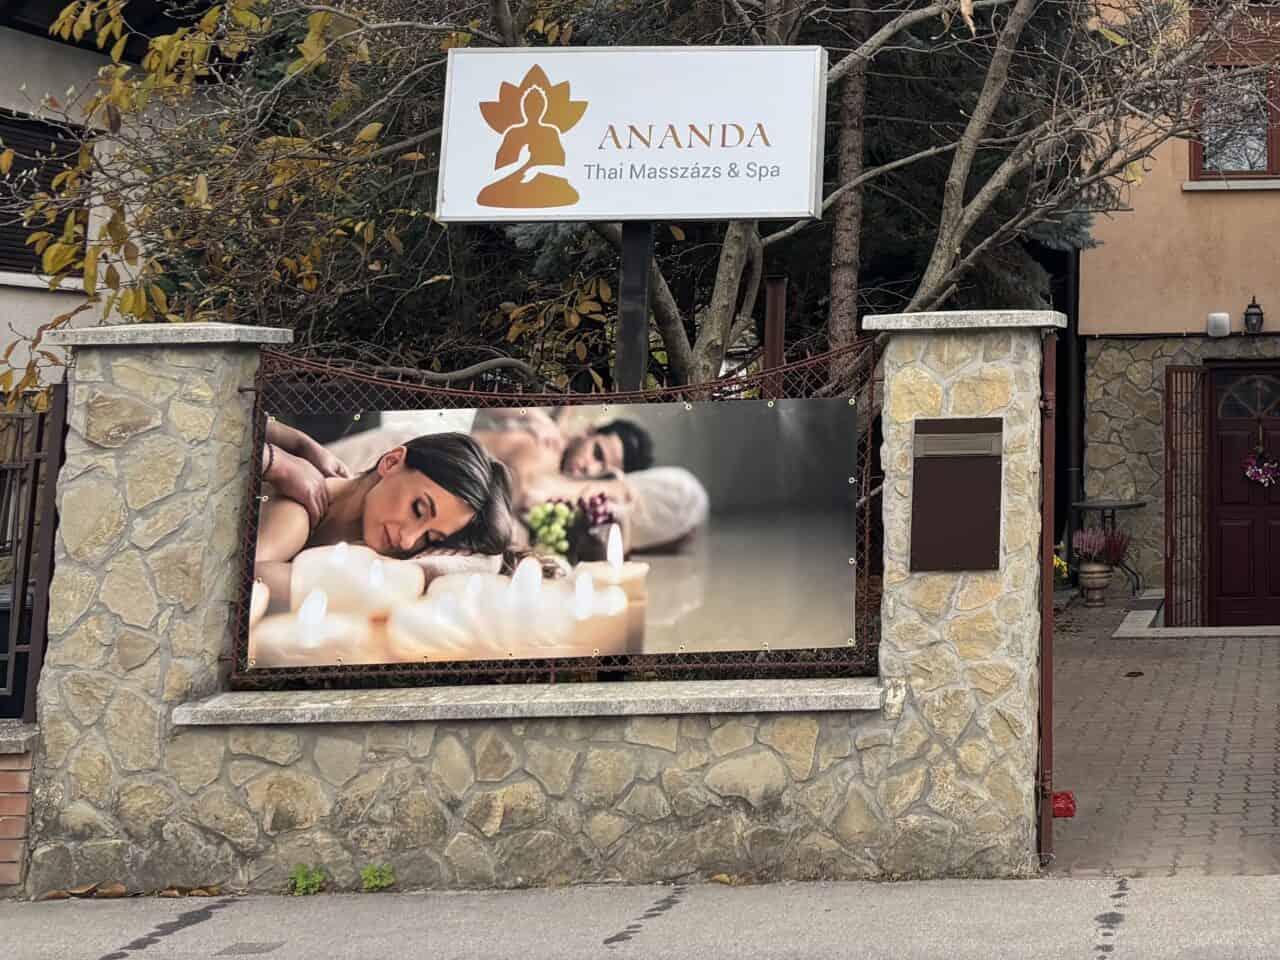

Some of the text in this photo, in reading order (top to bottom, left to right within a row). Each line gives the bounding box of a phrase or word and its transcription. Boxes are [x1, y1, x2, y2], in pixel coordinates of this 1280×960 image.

[598, 123, 771, 150] ANANDA
[584, 161, 781, 181] Thai Masszázs & Spa
